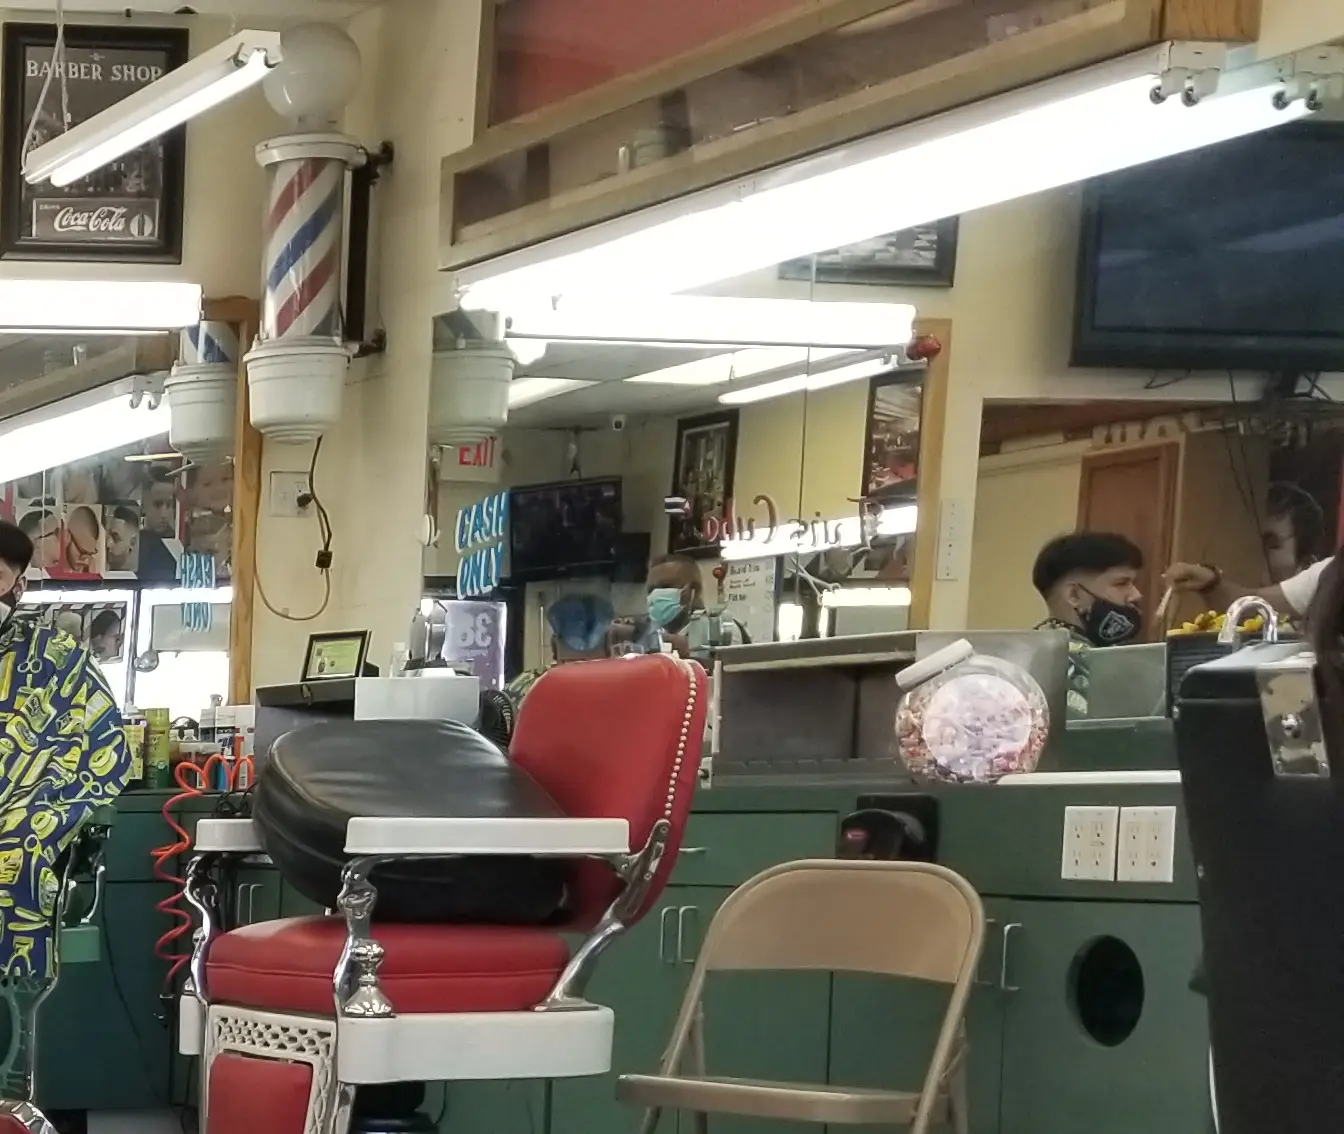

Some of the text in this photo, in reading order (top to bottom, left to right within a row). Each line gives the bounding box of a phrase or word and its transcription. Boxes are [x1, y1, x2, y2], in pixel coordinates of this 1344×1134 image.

[26, 60, 163, 82] BARBER SHOP
[53, 206, 128, 232] Coca-Cola
[459, 436, 497, 468] EXIT
[455, 490, 508, 553] CASH
[456, 541, 503, 600] ONLY
